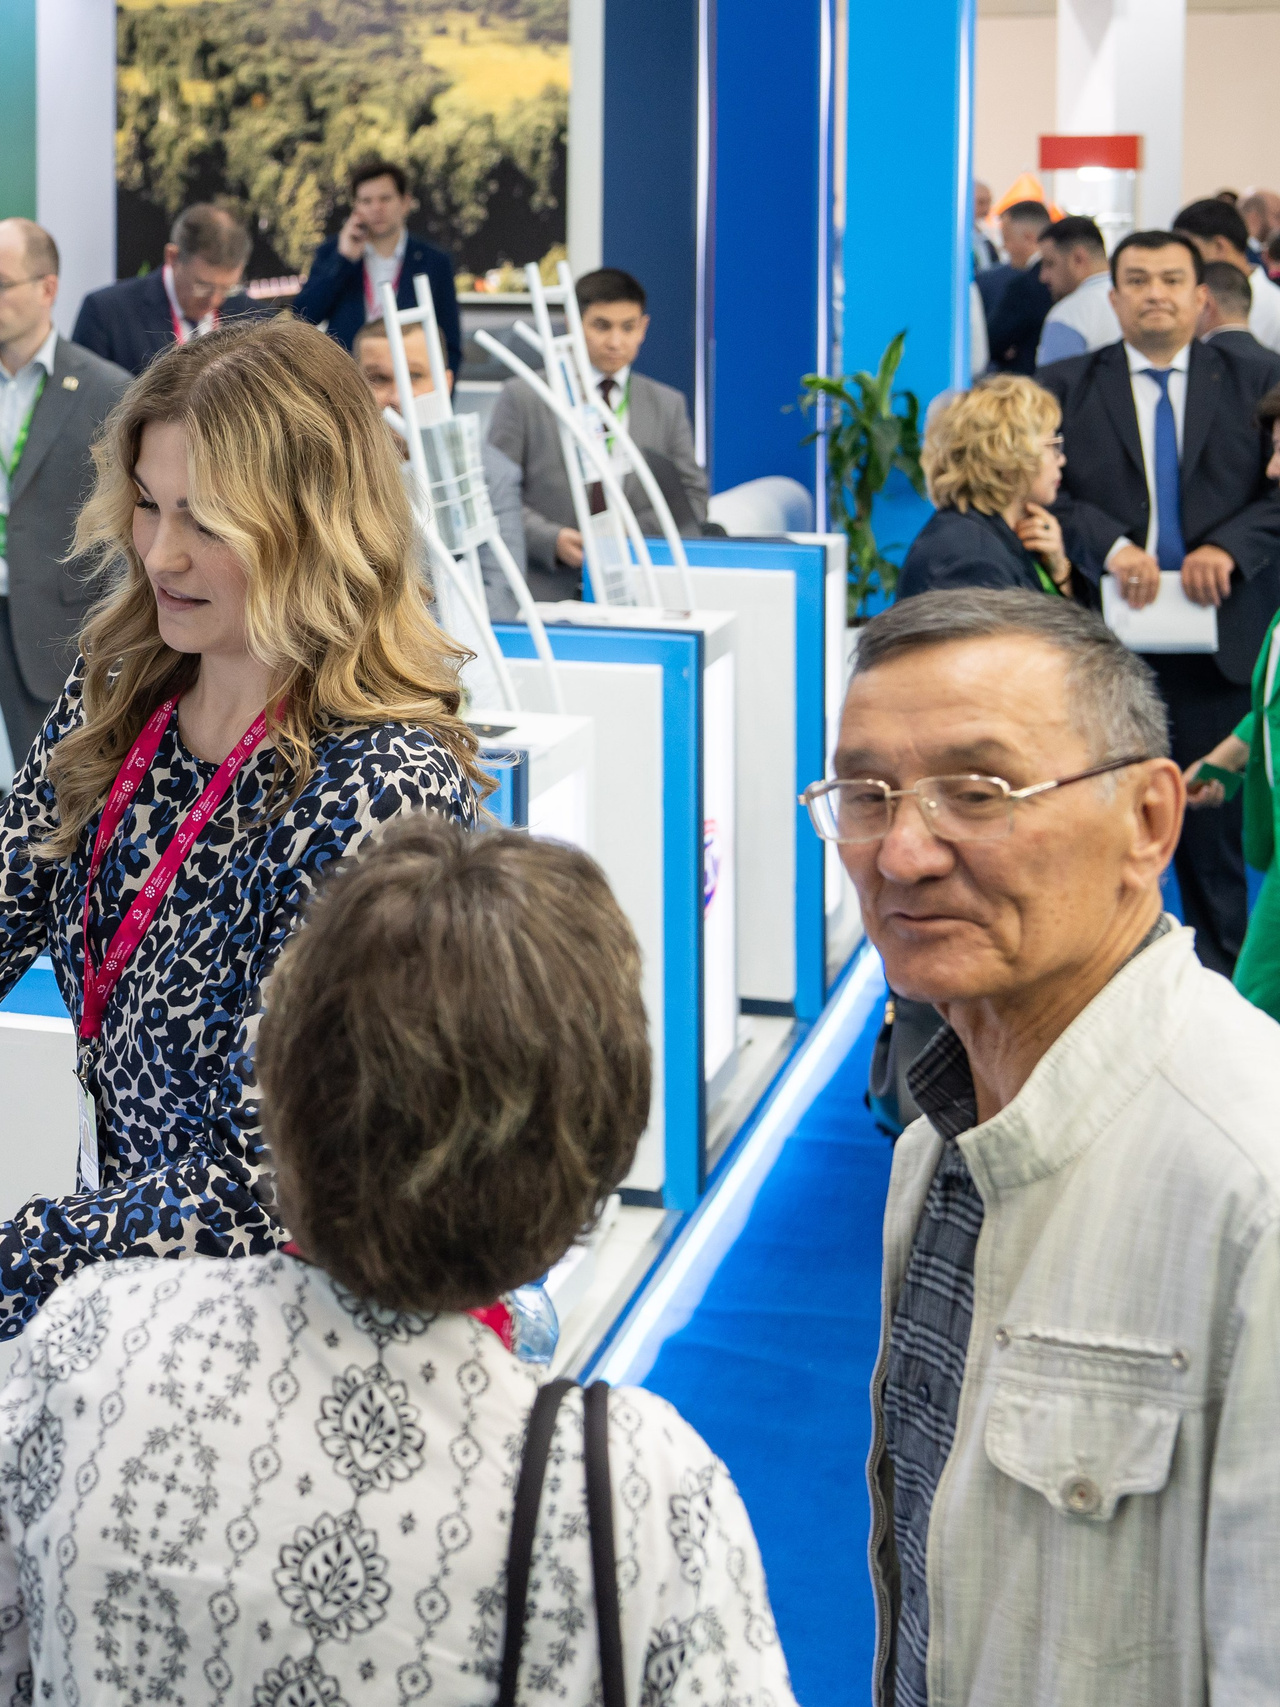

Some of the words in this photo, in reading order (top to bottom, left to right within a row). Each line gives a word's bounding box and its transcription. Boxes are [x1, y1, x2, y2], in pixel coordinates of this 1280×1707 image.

[125, 746, 139, 770] INNOPROM
[179, 831, 194, 853] INNOPROM
[137, 908, 151, 929] INNOPROM
